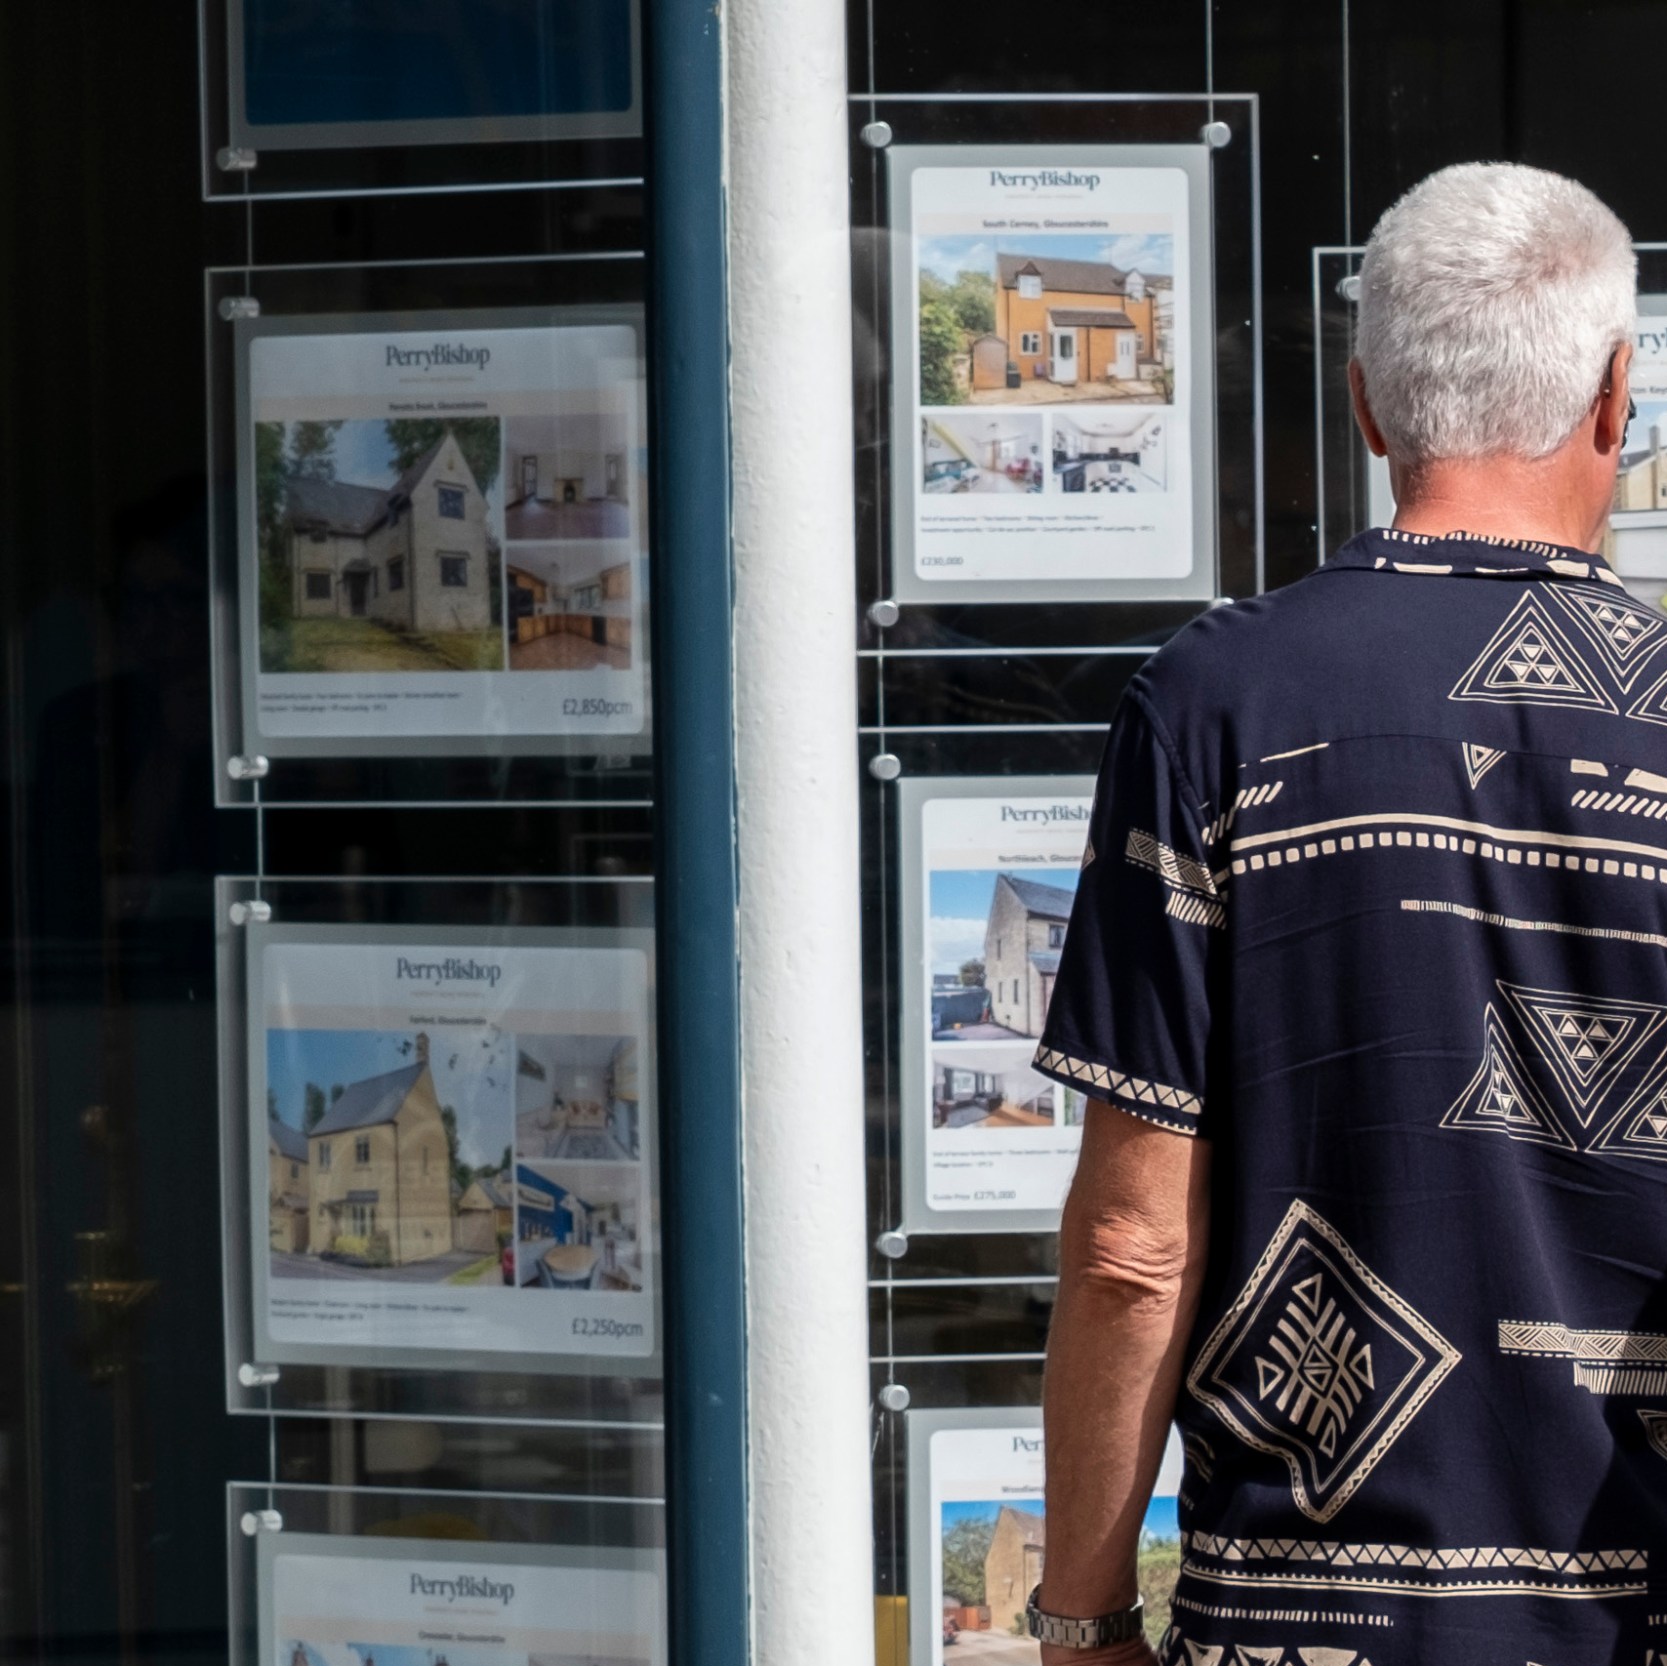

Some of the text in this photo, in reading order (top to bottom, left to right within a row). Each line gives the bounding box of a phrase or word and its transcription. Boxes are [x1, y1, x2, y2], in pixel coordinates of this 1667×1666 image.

[989, 170, 1101, 192] PerryBishop
[982, 218, 1110, 231] South Cerney, Gloucestershire
[385, 343, 491, 371] PerryBishop
[1630, 385, 1646, 395] ton
[1000, 804, 1089, 826] PerryBish
[396, 957, 502, 988] PerryBishop
[410, 1572, 515, 1606] PerryBishop
